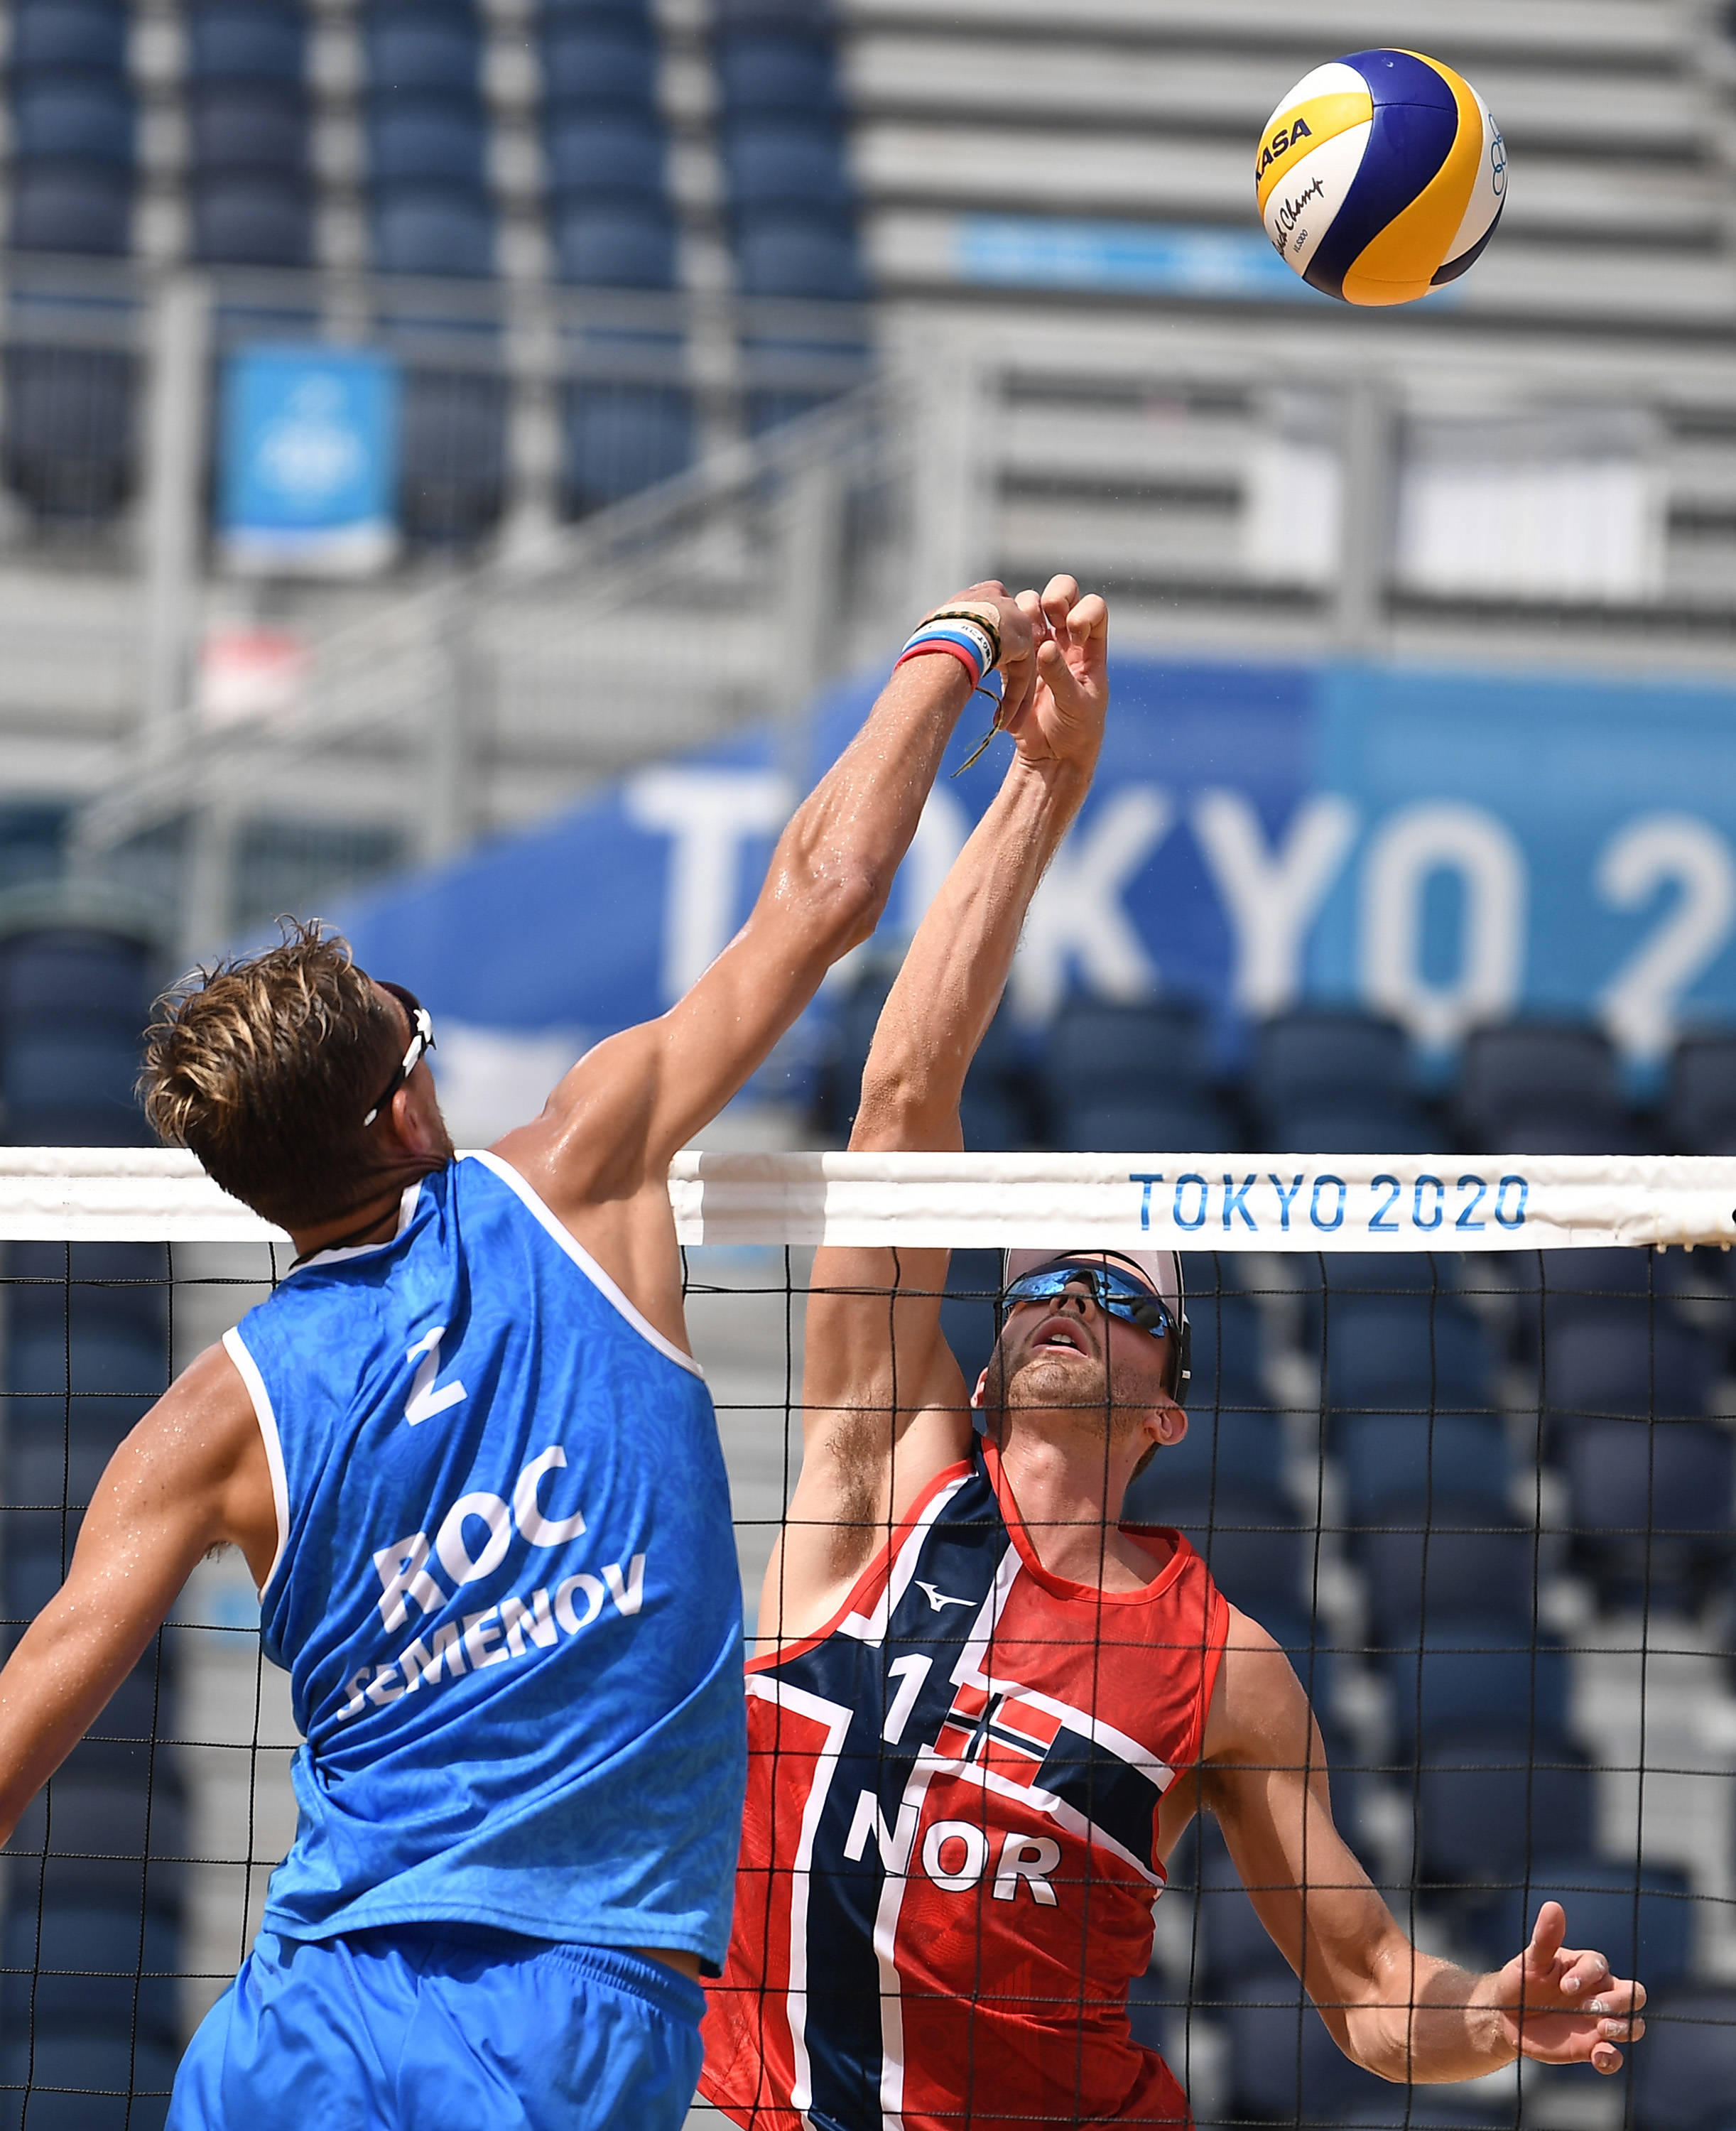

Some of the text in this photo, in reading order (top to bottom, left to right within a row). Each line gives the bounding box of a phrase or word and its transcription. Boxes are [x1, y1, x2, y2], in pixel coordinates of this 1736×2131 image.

[1279, 177, 1324, 231] Champ
[1129, 1173, 1529, 1232] TOKYO 2020
[404, 1325, 468, 1427] 2
[373, 1445, 587, 1634] ROC
[337, 1553, 646, 1721] SEMENOV
[881, 1653, 933, 1746] 1
[843, 1789, 1061, 1907] NOR
